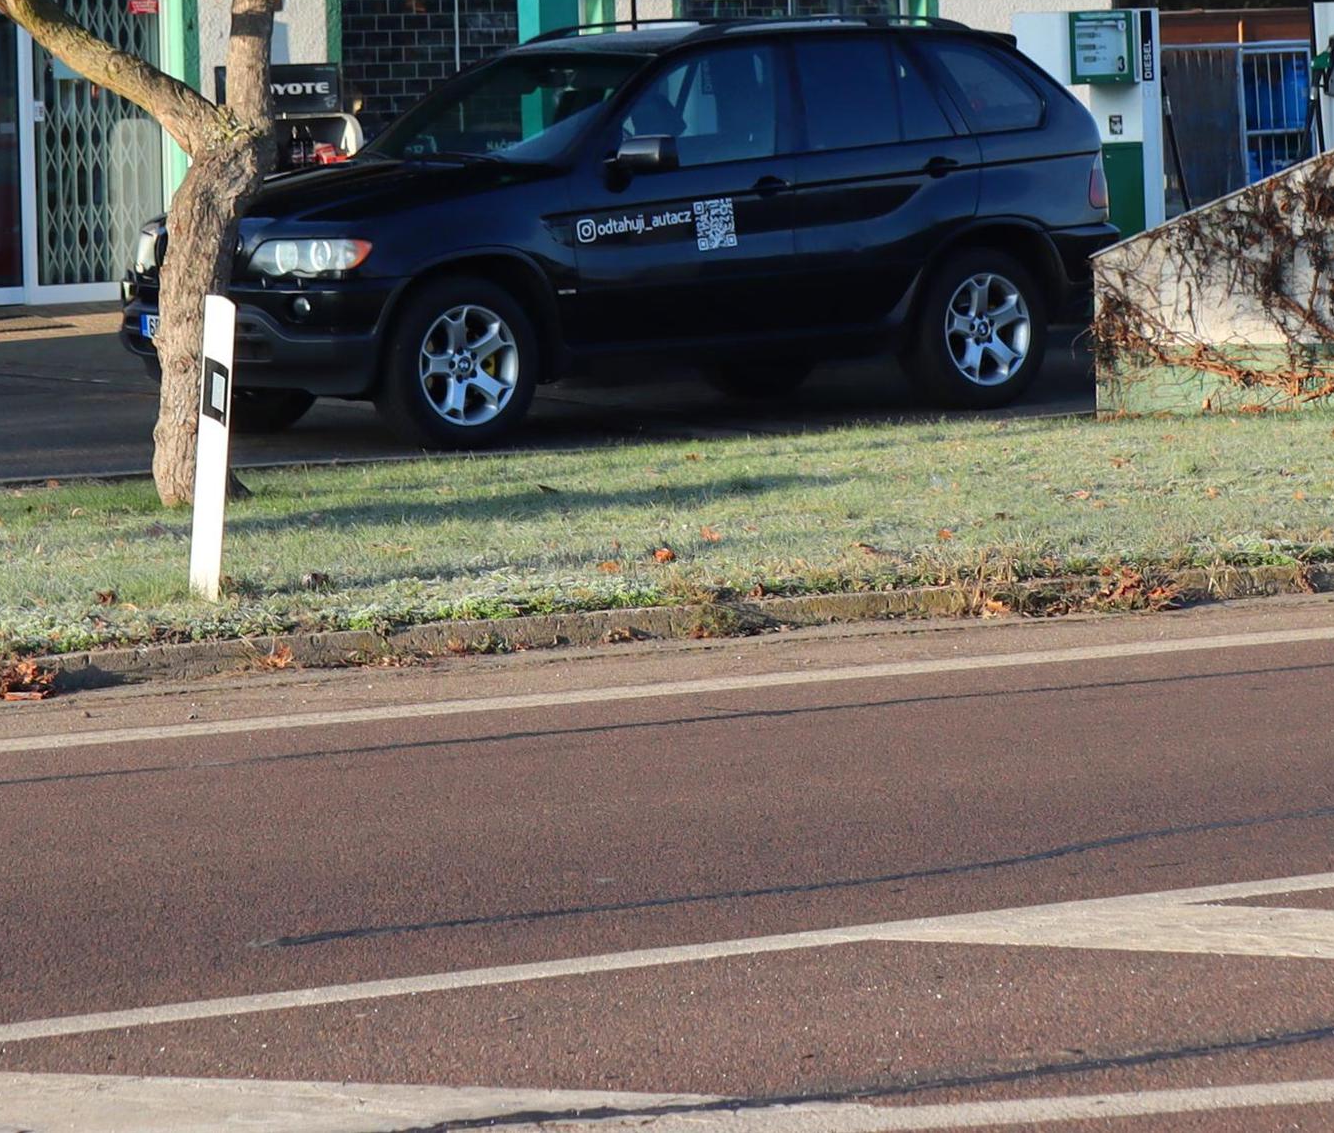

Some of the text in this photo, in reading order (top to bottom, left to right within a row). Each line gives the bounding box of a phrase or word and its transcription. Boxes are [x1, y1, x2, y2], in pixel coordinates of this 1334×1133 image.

[1117, 55, 1126, 72] 3
[1144, 40, 1153, 79] DIESEL
[270, 81, 330, 95] YOTE
[597, 210, 692, 235] odtahuji_autacz
